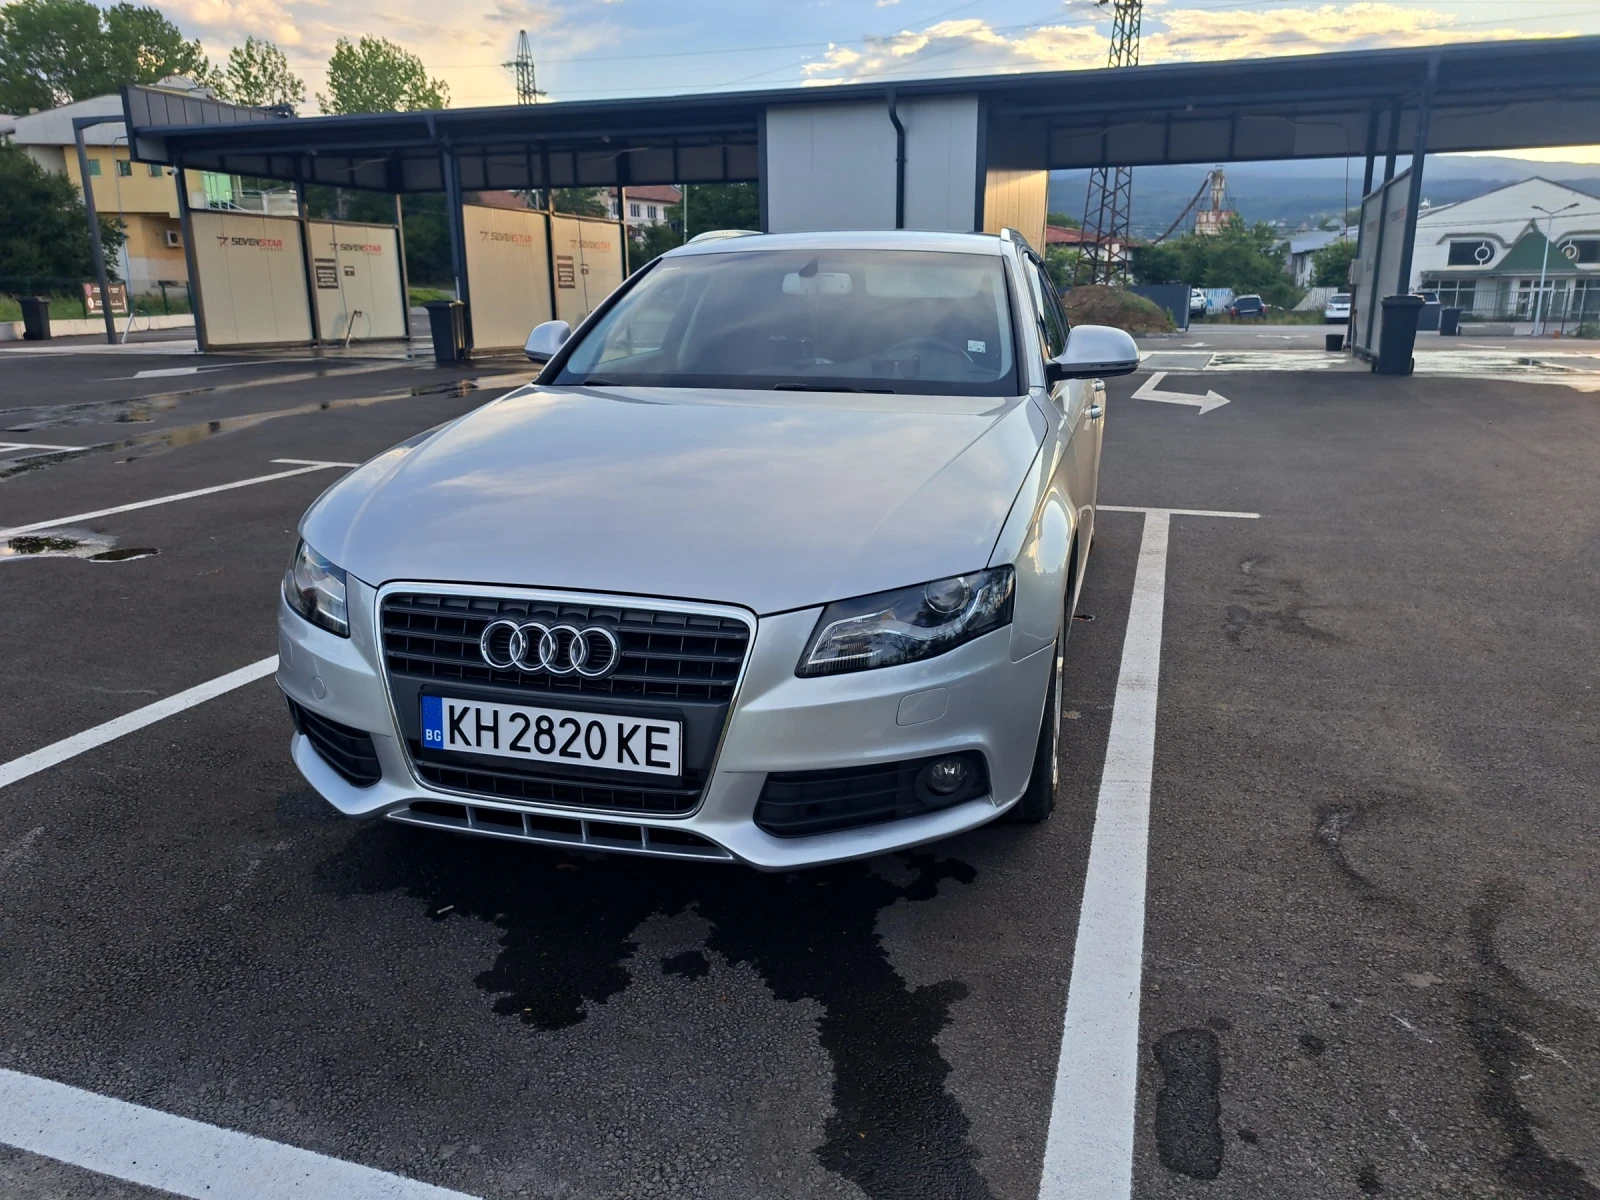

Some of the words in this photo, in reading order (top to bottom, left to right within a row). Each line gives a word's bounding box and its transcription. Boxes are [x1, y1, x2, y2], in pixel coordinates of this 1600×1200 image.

[231, 237, 283, 247] SEVENSTAR
[490, 231, 532, 243] SEVENSTAR
[340, 243, 382, 252] SEVENSTAR
[425, 728, 442, 742] BG
[448, 704, 499, 750] KH
[508, 711, 607, 761] 2820
[616, 722, 671, 769] KE
